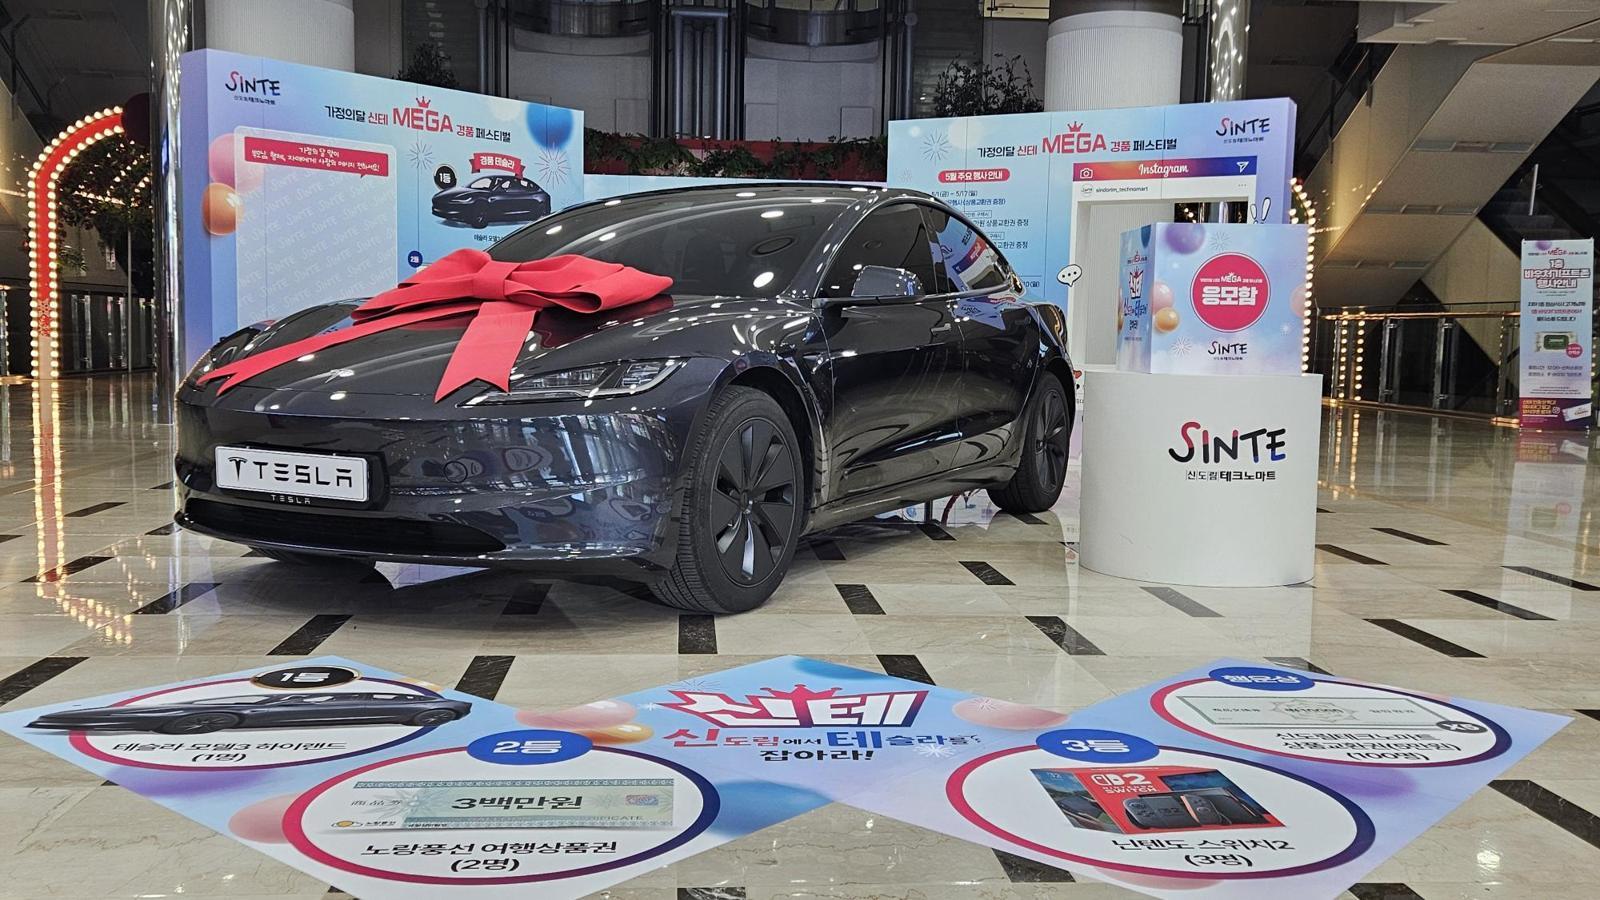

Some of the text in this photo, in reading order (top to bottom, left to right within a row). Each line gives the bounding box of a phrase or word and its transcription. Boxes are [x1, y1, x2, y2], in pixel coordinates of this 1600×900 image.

[225, 71, 280, 96] SINTE
[324, 105, 511, 143] 가정의달 신테 MEGA 경품 페스티벌
[1216, 118, 1270, 136] SINTE
[977, 133, 1177, 158] 가정의달 신테 MEGA 경품 페스티벌
[480, 156, 515, 169] 경품 테슬라
[1138, 163, 1189, 176] Instagram
[439, 173, 452, 184] 1등
[945, 172, 957, 181] 5월
[957, 172, 973, 181] 주요
[986, 219, 1016, 227] 상품교환권
[1202, 285, 1258, 306] 응모함
[1207, 341, 1248, 355] SINTE
[1168, 421, 1286, 463] SINTE
[253, 461, 352, 488] TESLA
[271, 494, 311, 504] TESLA
[279, 672, 330, 683] 1등
[657, 689, 929, 728] 신테
[663, 728, 821, 748] 신도림에서
[112, 743, 185, 752] 테슬라
[190, 743, 252, 751] 모델3
[493, 740, 561, 754] 2등
[1060, 738, 1131, 754] 3등
[191, 753, 247, 763] (1명)
[760, 750, 874, 762] 잡아라!
[1347, 752, 1430, 761] (100명)
[1122, 773, 1152, 785] 2
[451, 796, 582, 810] 3백만원
[361, 841, 618, 857] 노랑풍선 여행상품권
[1112, 838, 1296, 852] 닌텐도 스위치2
[450, 858, 521, 873] (2명)
[1184, 853, 1253, 869] (3명)
